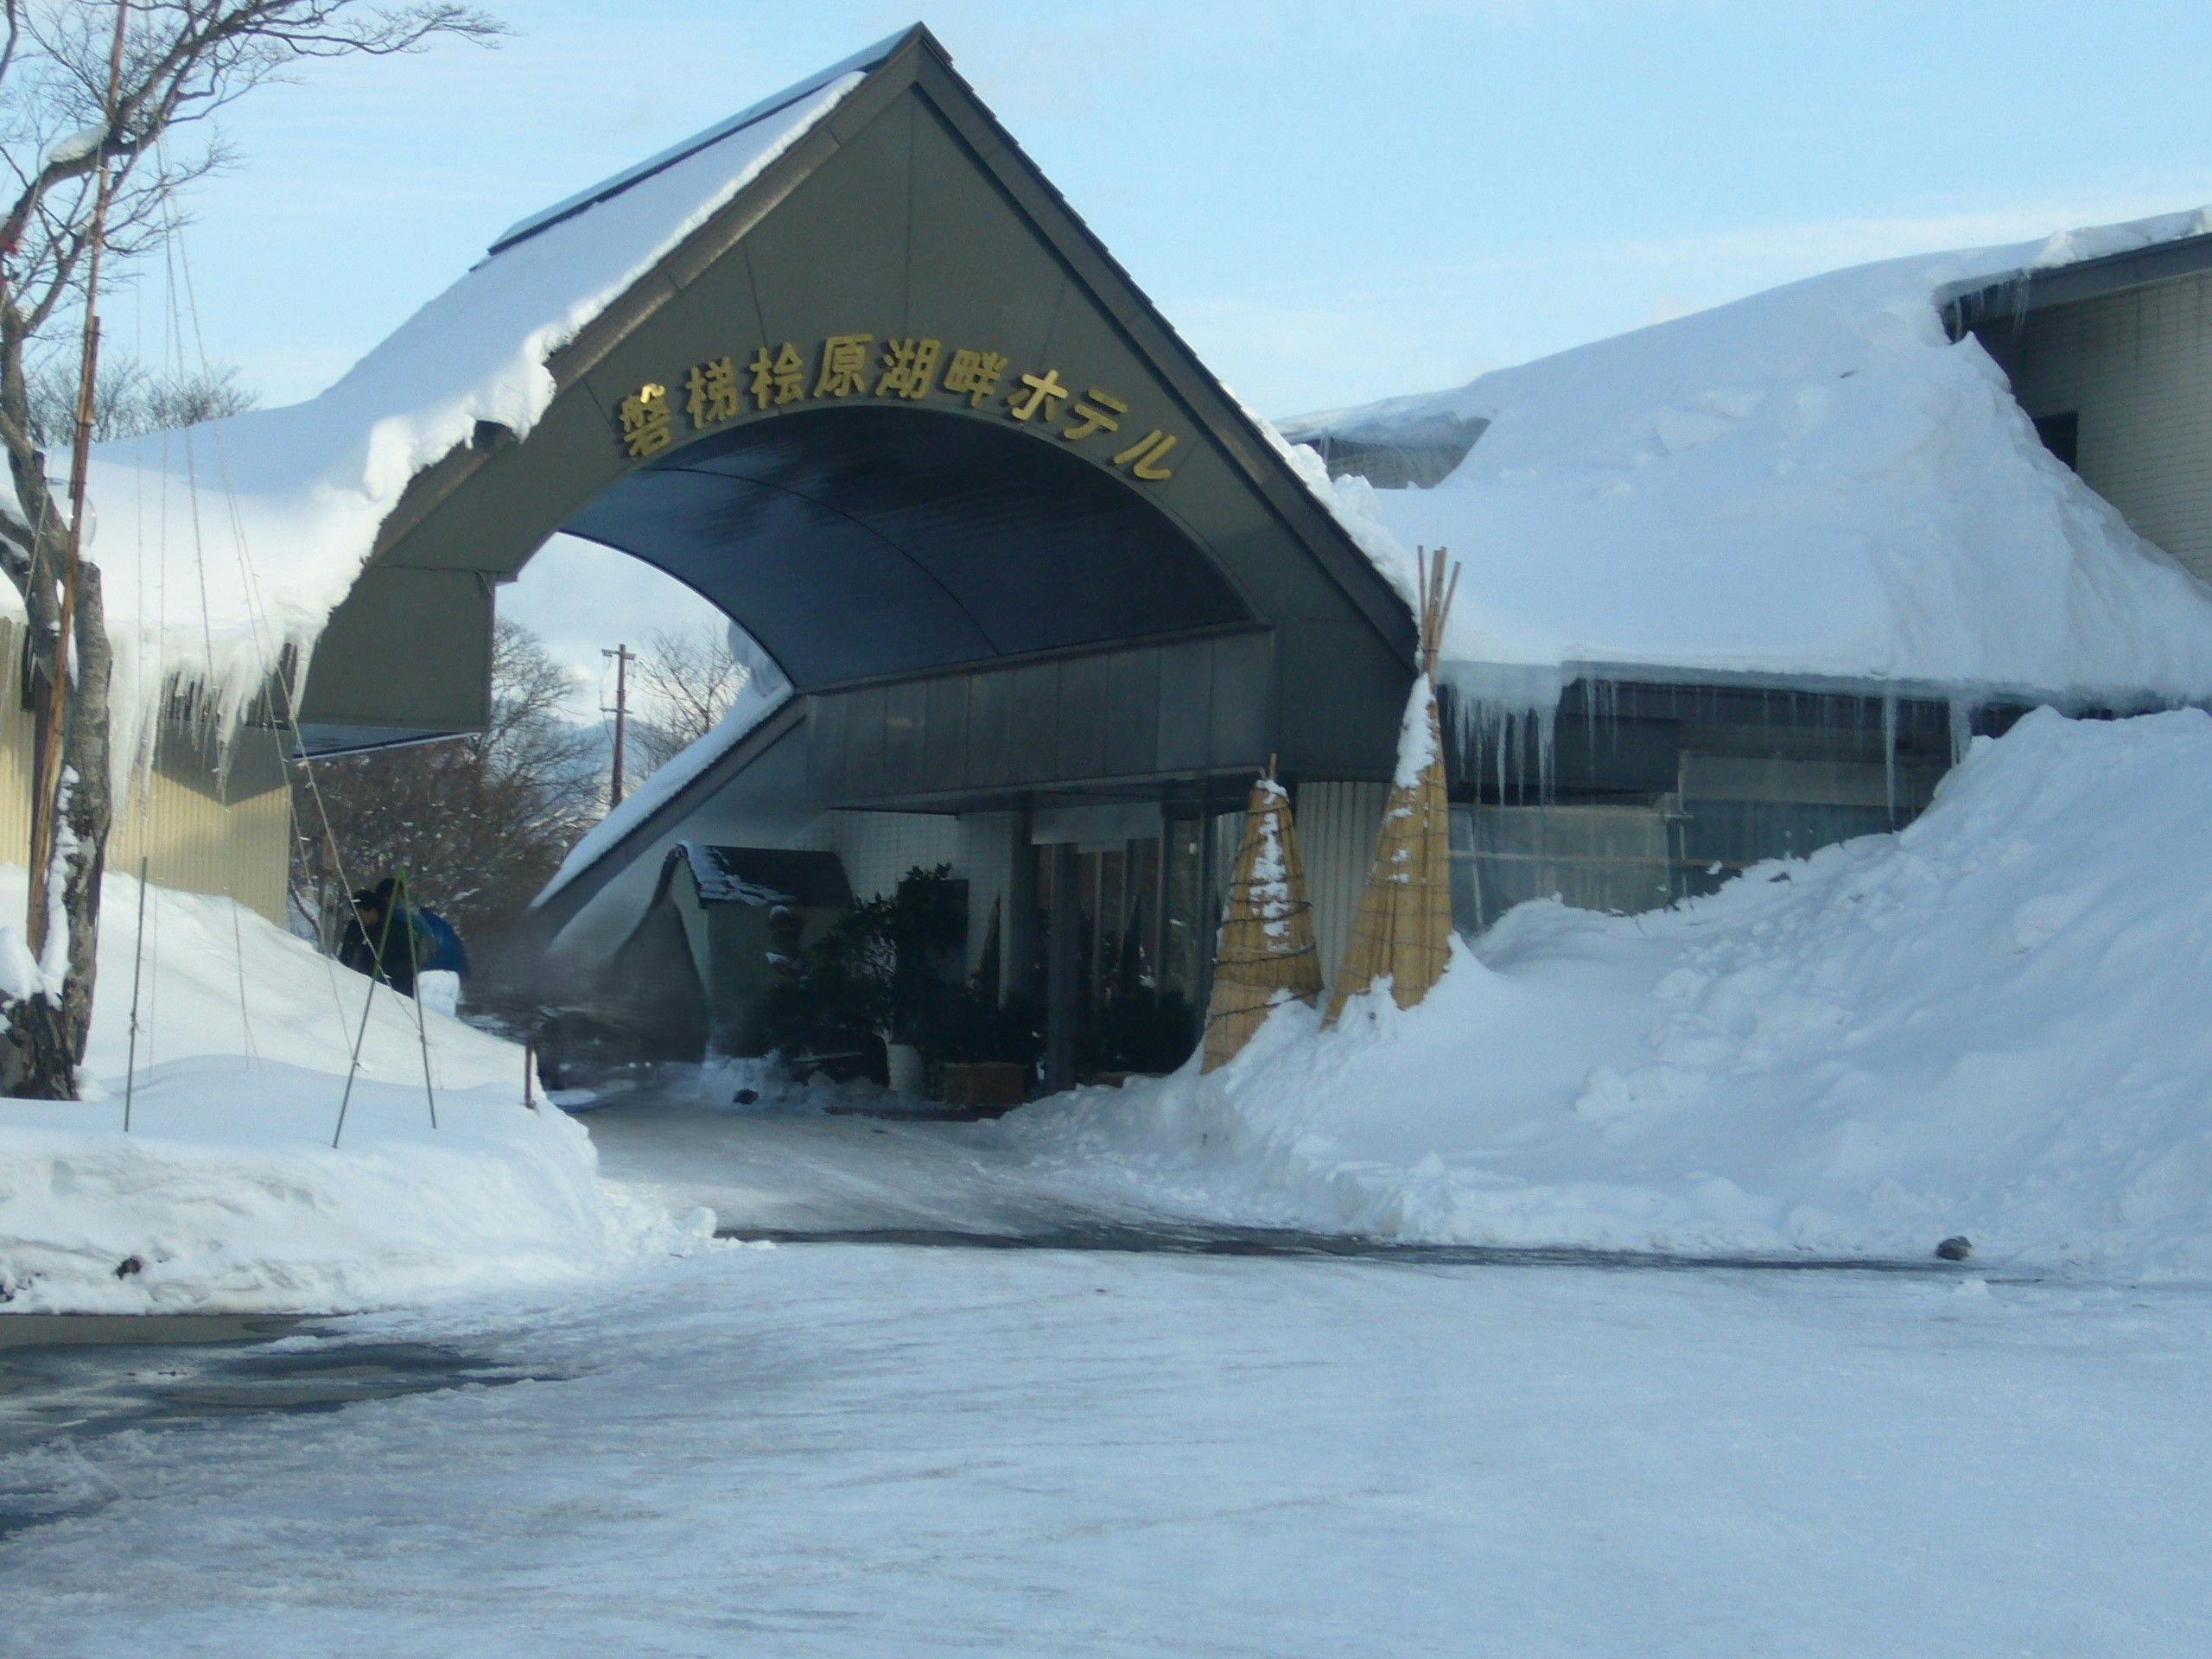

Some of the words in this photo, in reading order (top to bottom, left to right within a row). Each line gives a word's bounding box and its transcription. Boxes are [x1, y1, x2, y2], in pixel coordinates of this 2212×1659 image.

[620, 334, 1176, 480] 磐梯桧原湖畔ホテル
